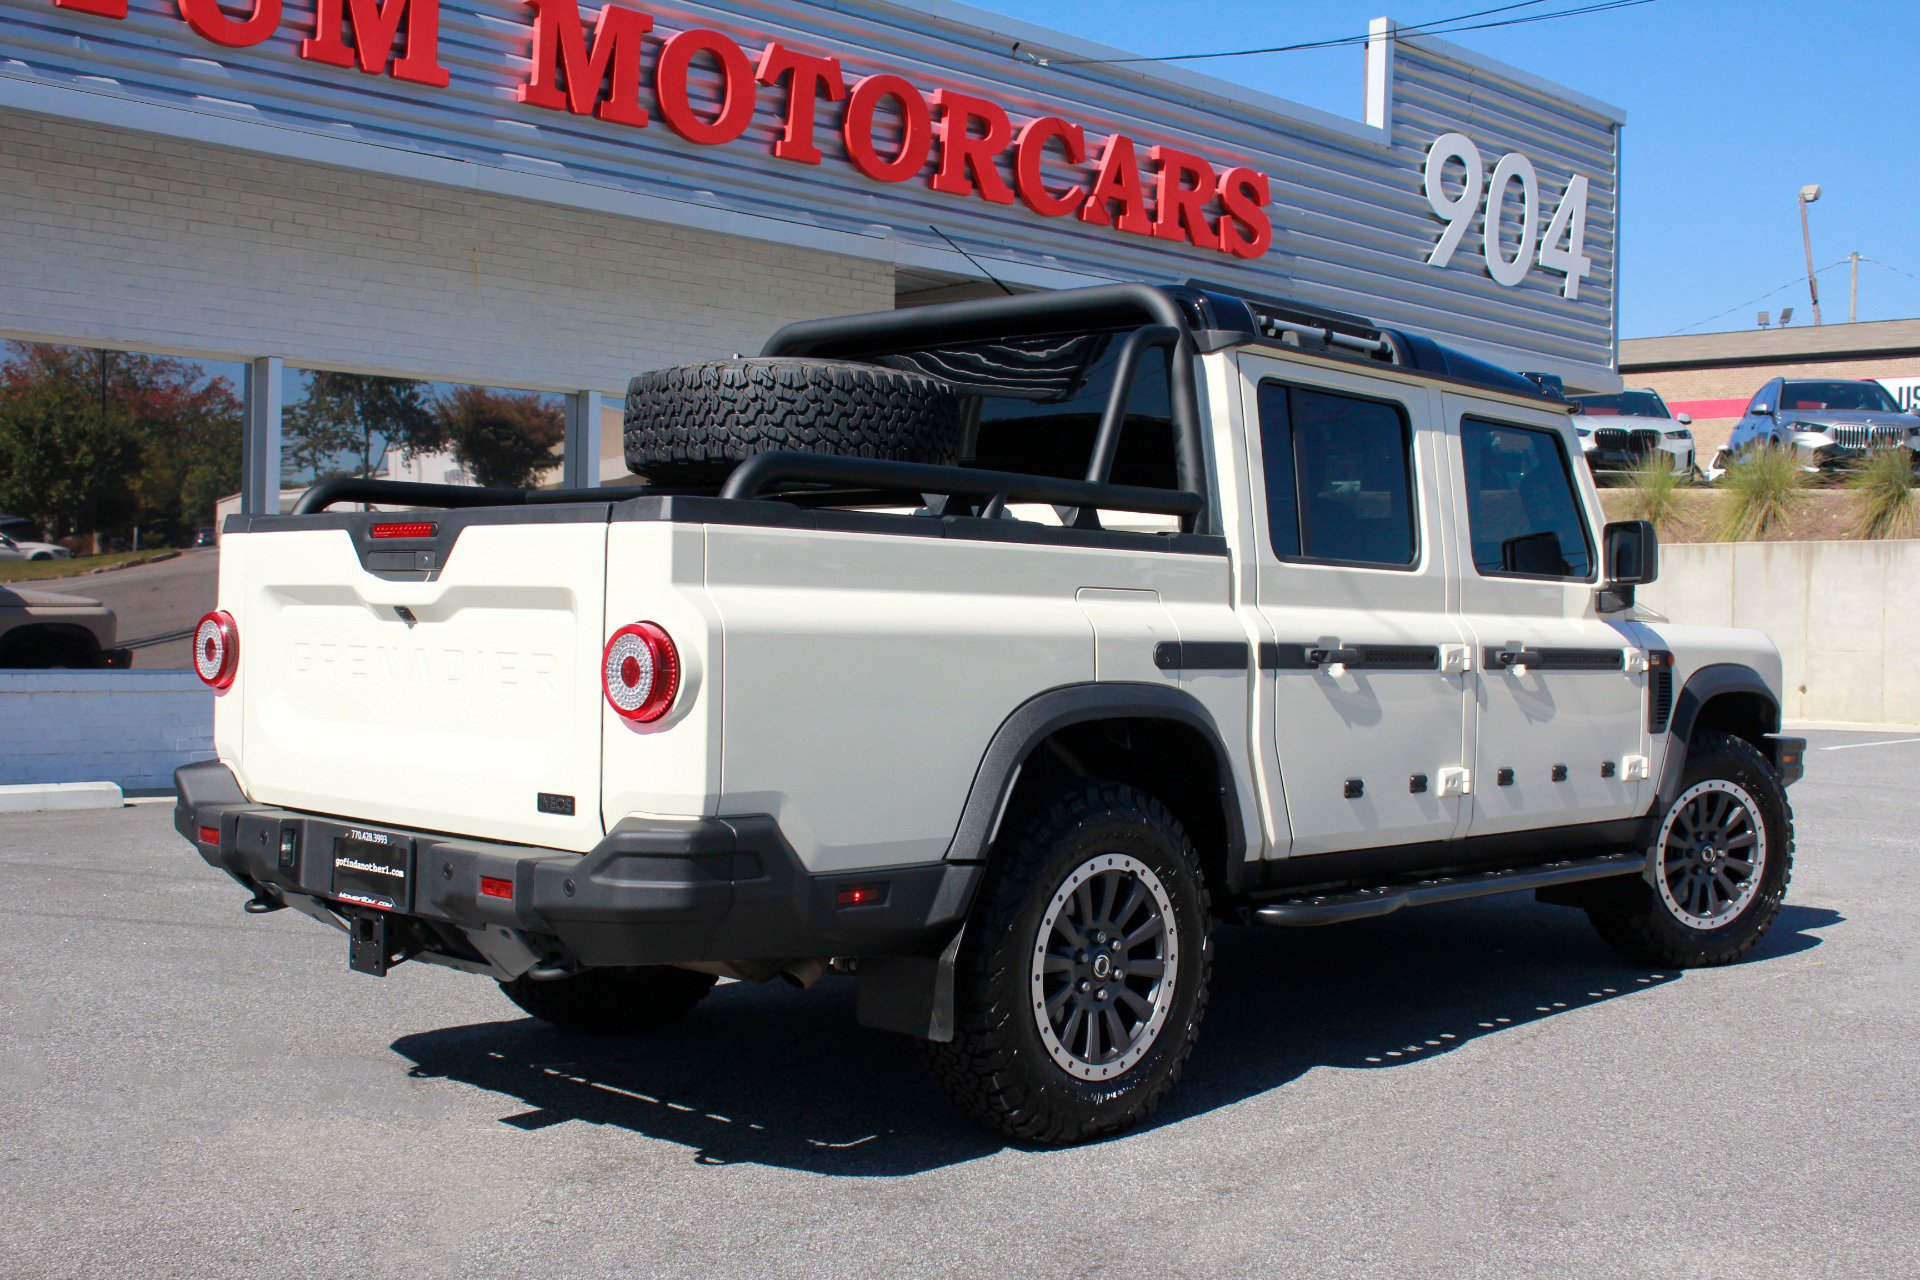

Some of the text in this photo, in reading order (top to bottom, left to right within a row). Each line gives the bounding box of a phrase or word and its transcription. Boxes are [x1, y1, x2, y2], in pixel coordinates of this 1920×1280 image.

[512, 0, 1271, 258] MOTORCARS
[1425, 132, 1590, 299] 904
[295, 642, 559, 691] GRENADIER
[351, 829, 388, 844] 770.428.3993
[335, 857, 404, 878] gofindanother1.com
